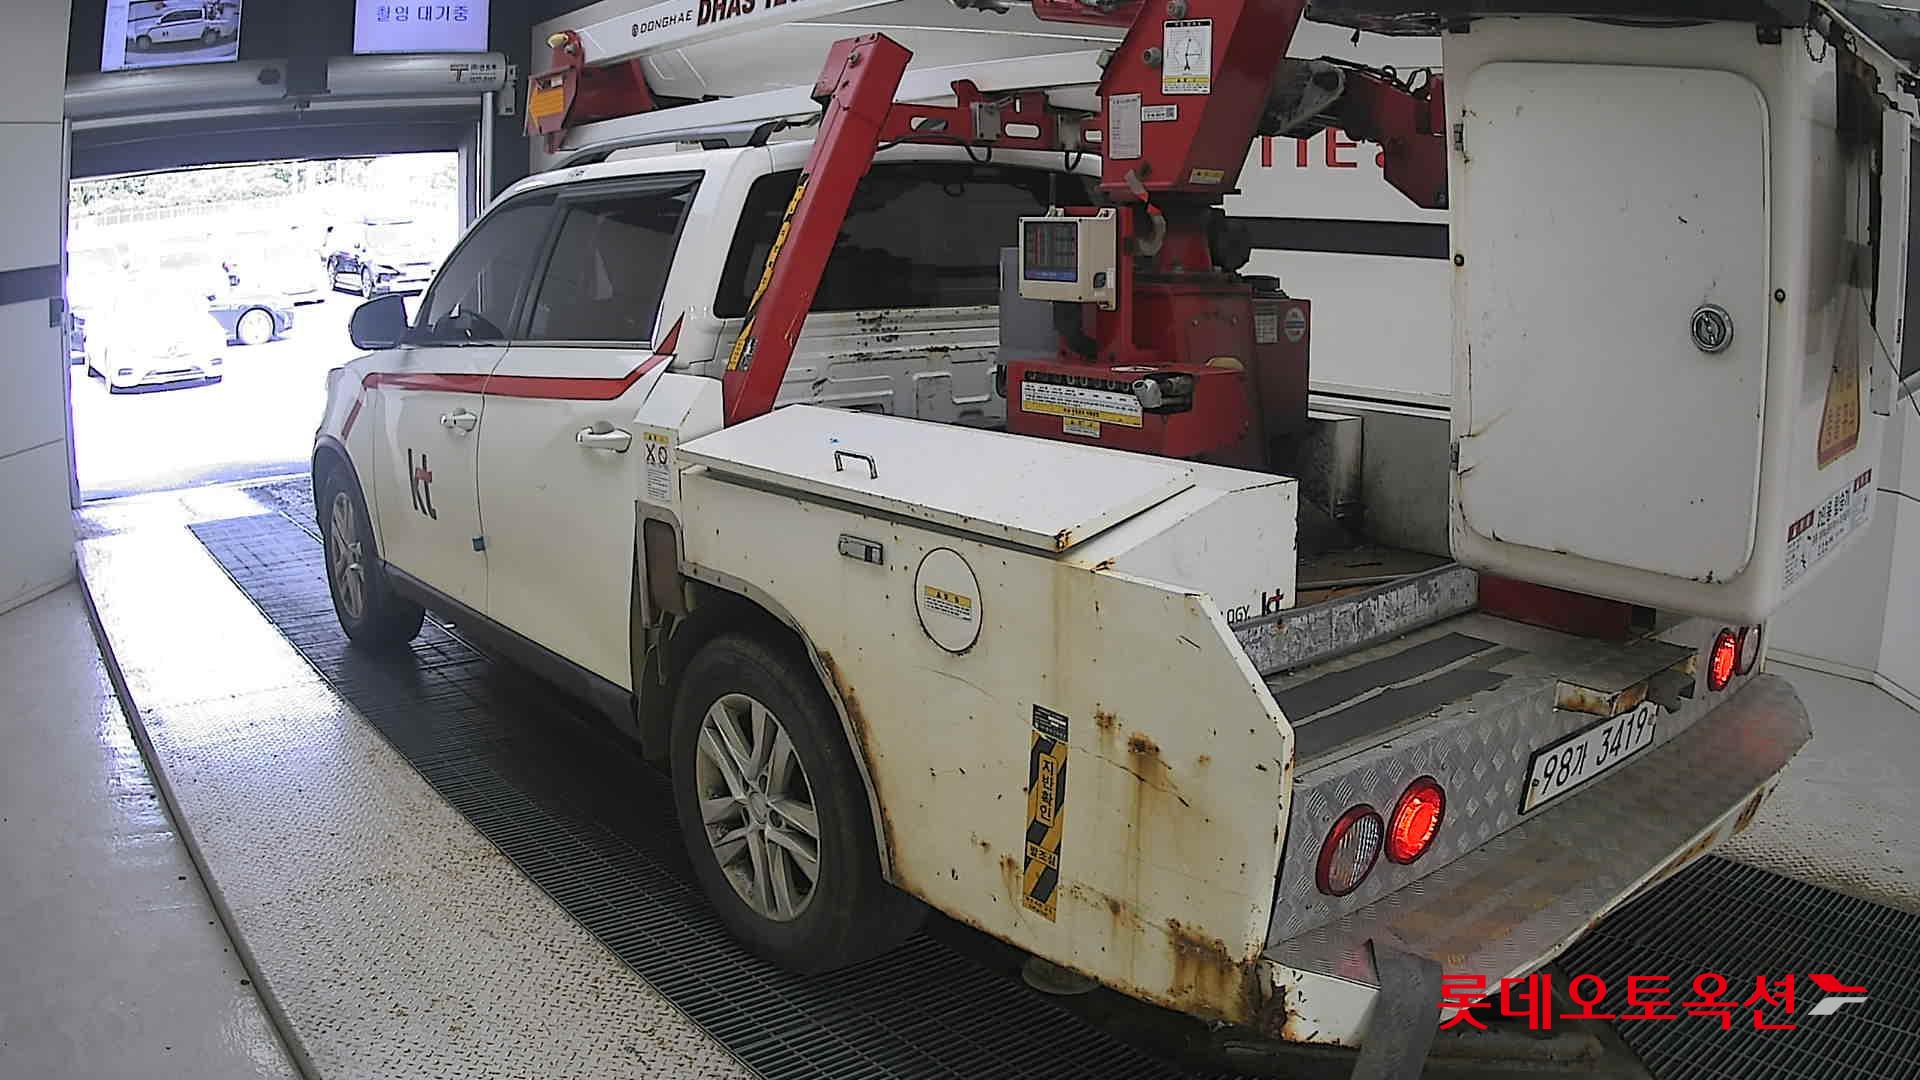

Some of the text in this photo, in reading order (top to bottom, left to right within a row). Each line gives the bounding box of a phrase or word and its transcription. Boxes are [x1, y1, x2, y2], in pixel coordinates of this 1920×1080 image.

[417, 5, 468, 22] 대기중
[640, 10, 693, 34] DONGHAE
[408, 448, 437, 520] kt
[1261, 588, 1284, 616] kt
[1542, 707, 1648, 795] 98가 3419
